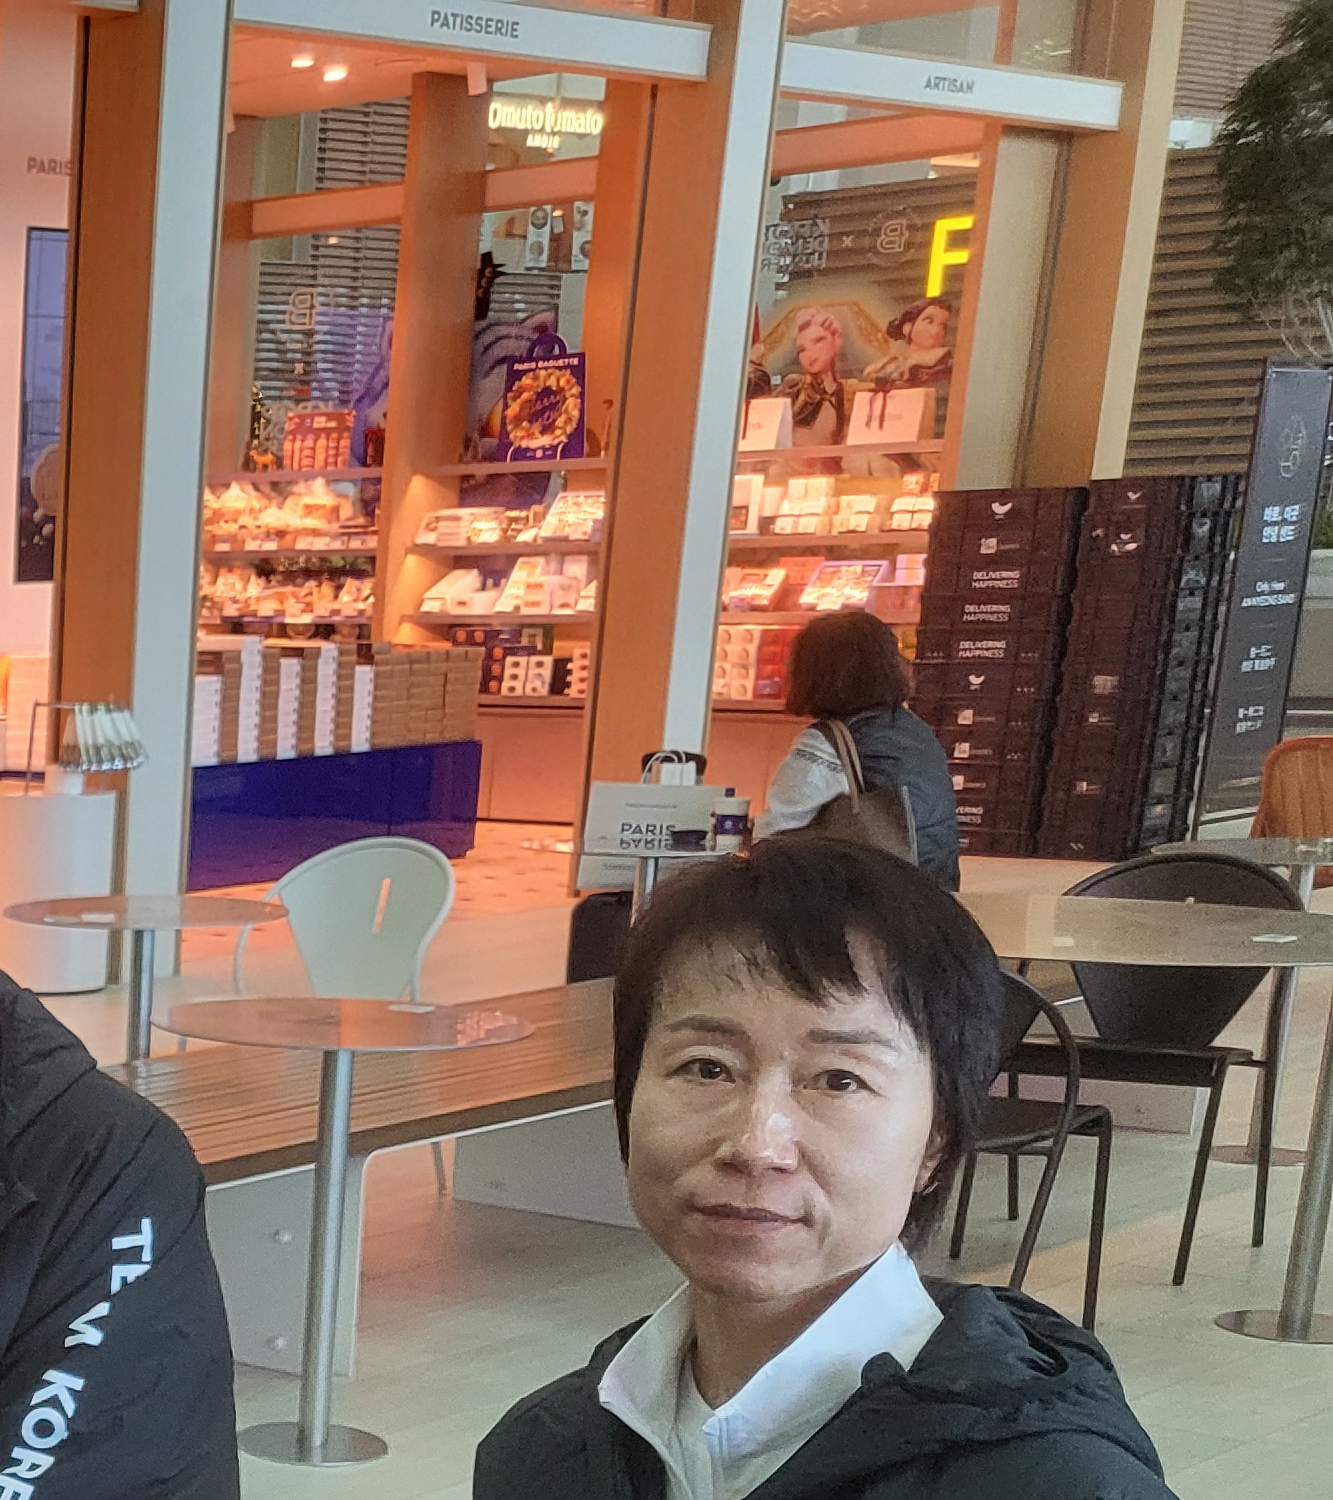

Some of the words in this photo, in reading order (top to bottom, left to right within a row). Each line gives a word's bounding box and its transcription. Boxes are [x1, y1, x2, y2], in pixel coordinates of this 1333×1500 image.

[430, 9, 521, 39] PATISSERIE
[923, 75, 975, 95] ARTISAN
[926, 215, 974, 299] F
[972, 571, 1021, 580] DELIVERING
[971, 580, 1020, 589] HAPPINESS
[964, 604, 1011, 613] DELIVERING
[962, 613, 1009, 622] HAPPINESS
[959, 640, 1007, 649] DELIVERING
[958, 649, 1005, 659] HAPPINESS
[620, 821, 676, 836] PARIS
[64, 1216, 155, 1349] TEM
